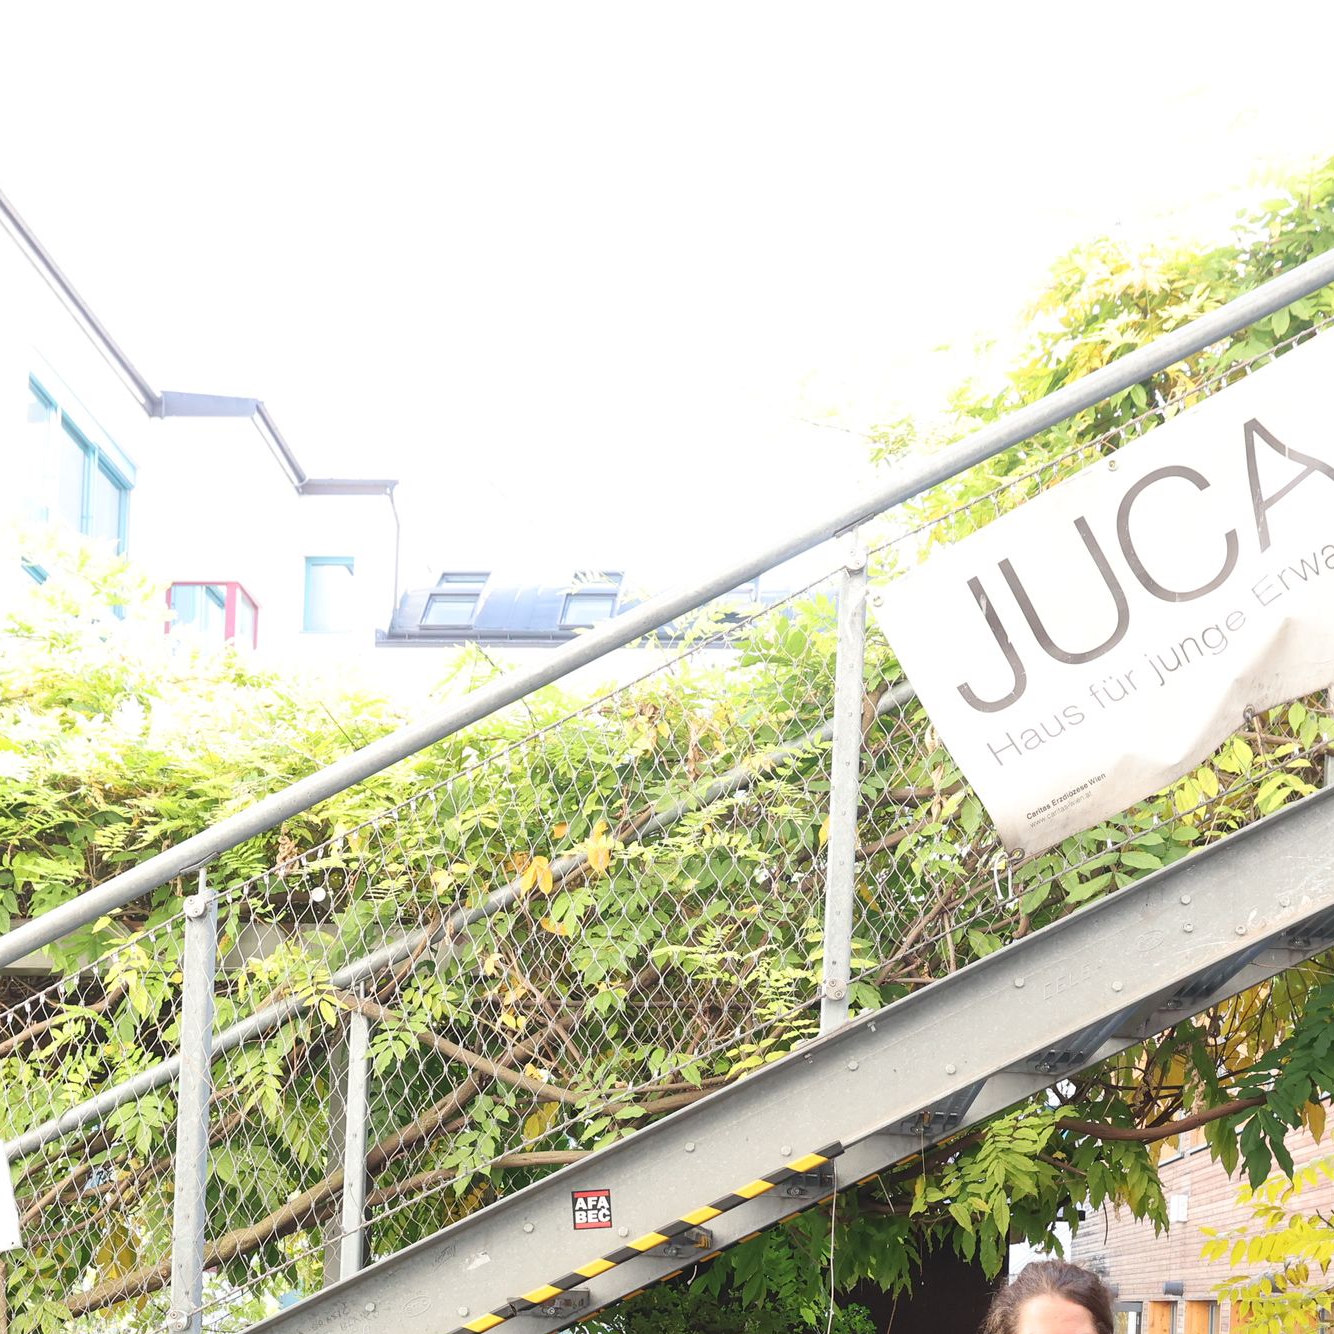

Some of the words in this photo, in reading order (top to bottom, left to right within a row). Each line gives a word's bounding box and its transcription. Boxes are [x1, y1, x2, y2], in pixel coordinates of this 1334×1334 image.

[986, 704, 1086, 767] Haus
[1088, 668, 1138, 709] für
[1144, 608, 1247, 687] junge
[1026, 803, 1052, 821] Caritas
[1087, 772, 1107, 786] Wien
[575, 1195, 610, 1210] AFA
